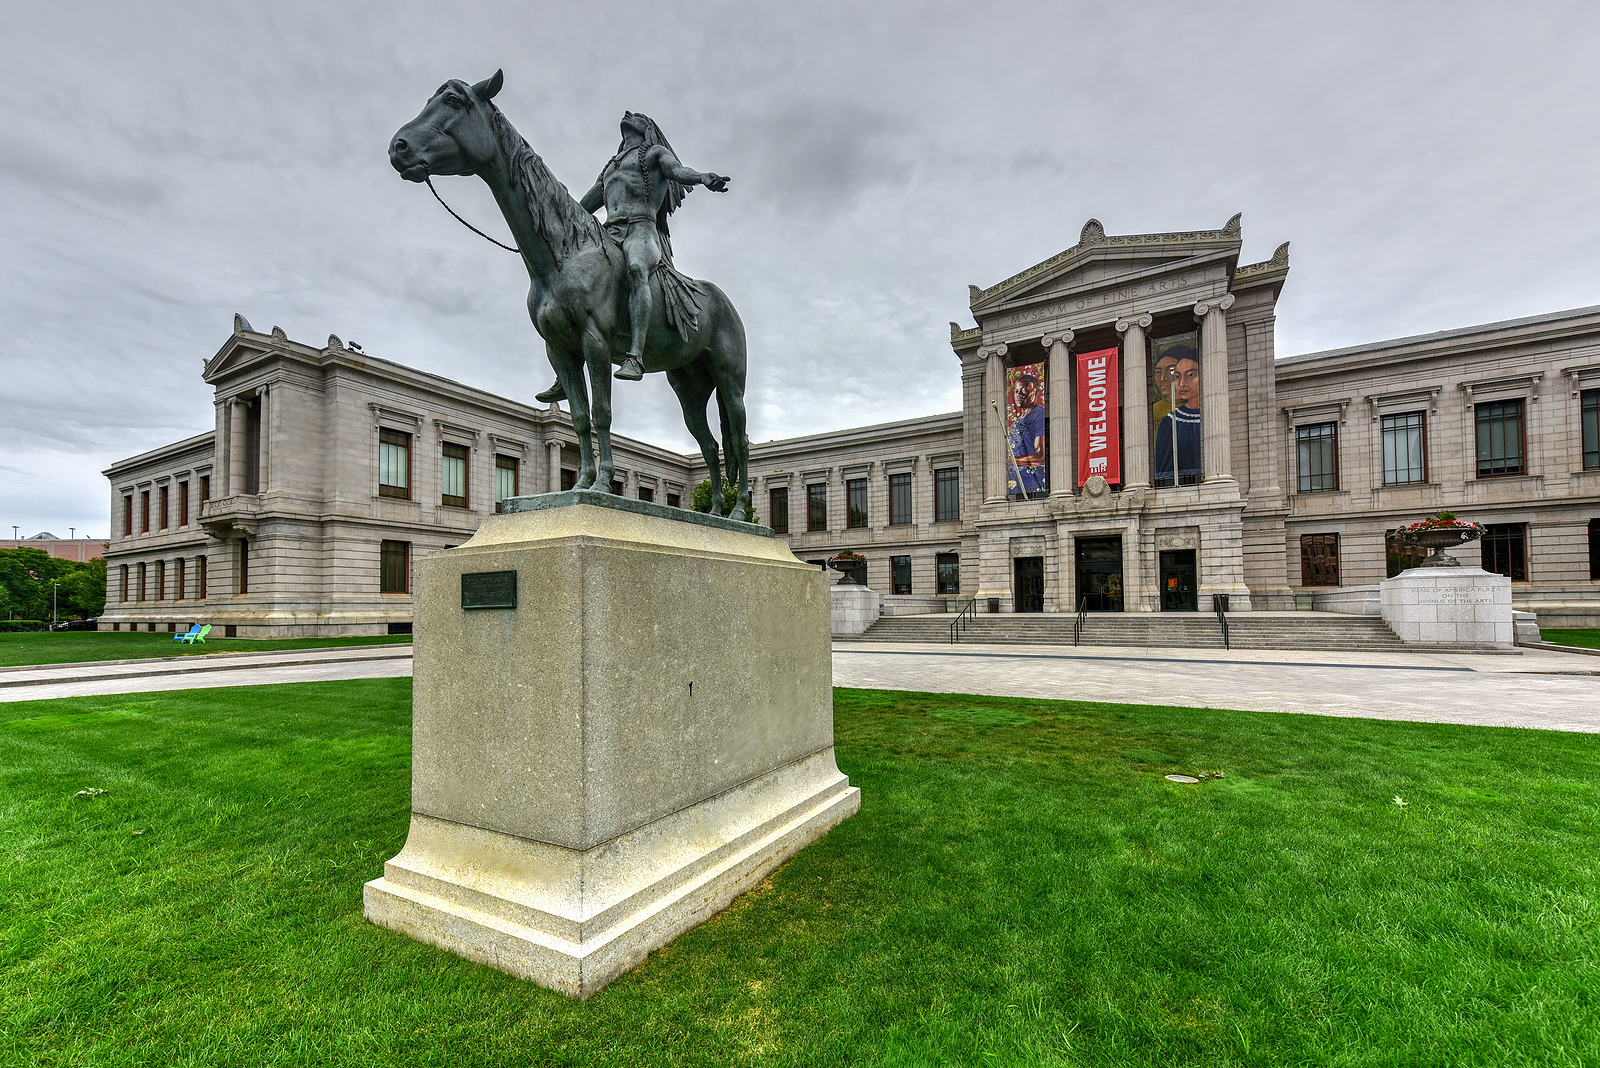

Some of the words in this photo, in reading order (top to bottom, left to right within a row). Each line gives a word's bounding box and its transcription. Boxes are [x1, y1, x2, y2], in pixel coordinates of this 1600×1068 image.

[1076, 298, 1093, 310] OF
[1103, 288, 1138, 304] FINE
[1147, 275, 1188, 294] ARTS
[1088, 357, 1107, 453] WELCOME
